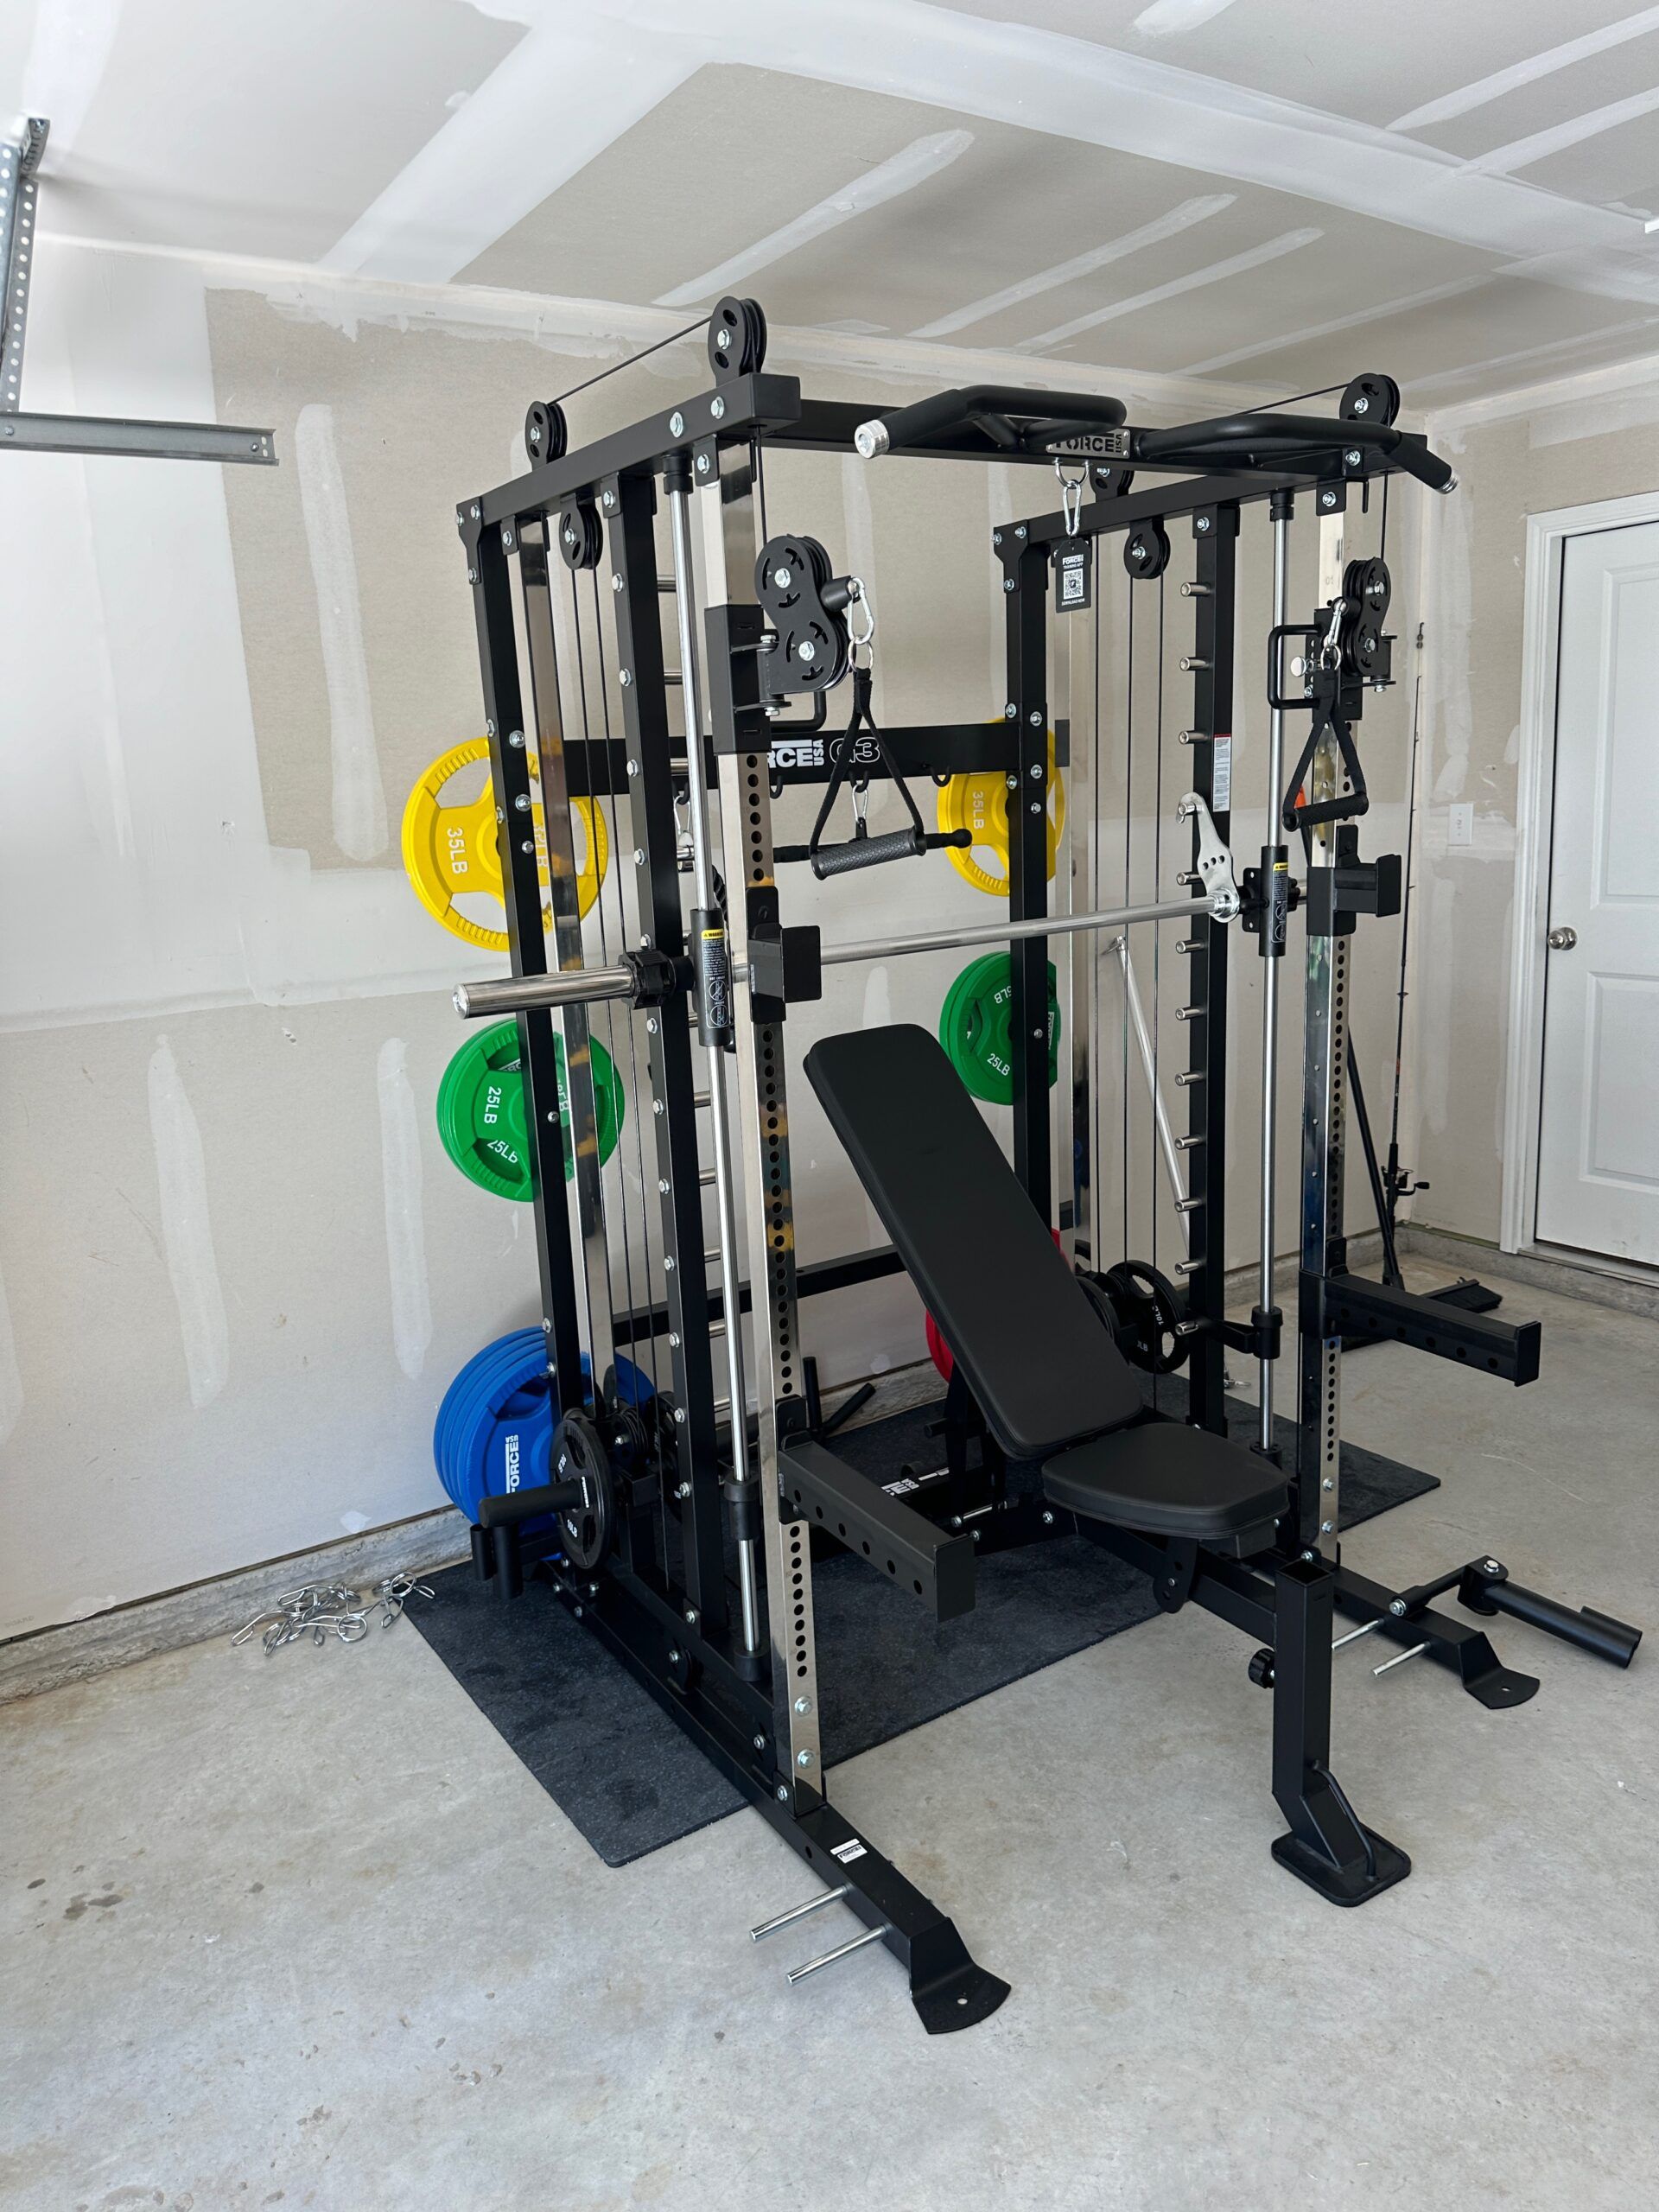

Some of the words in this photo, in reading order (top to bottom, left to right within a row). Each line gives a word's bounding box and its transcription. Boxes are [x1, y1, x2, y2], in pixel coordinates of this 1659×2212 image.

[767, 740, 812, 768] RCE
[813, 739, 824, 766] USA
[972, 791, 984, 829] 35LB
[447, 827, 468, 874] 35LB
[994, 985, 1012, 1004] 5LB
[987, 1053, 1010, 1076] 25LB
[484, 1086, 502, 1124] 25LB
[505, 1434, 518, 1444] USA
